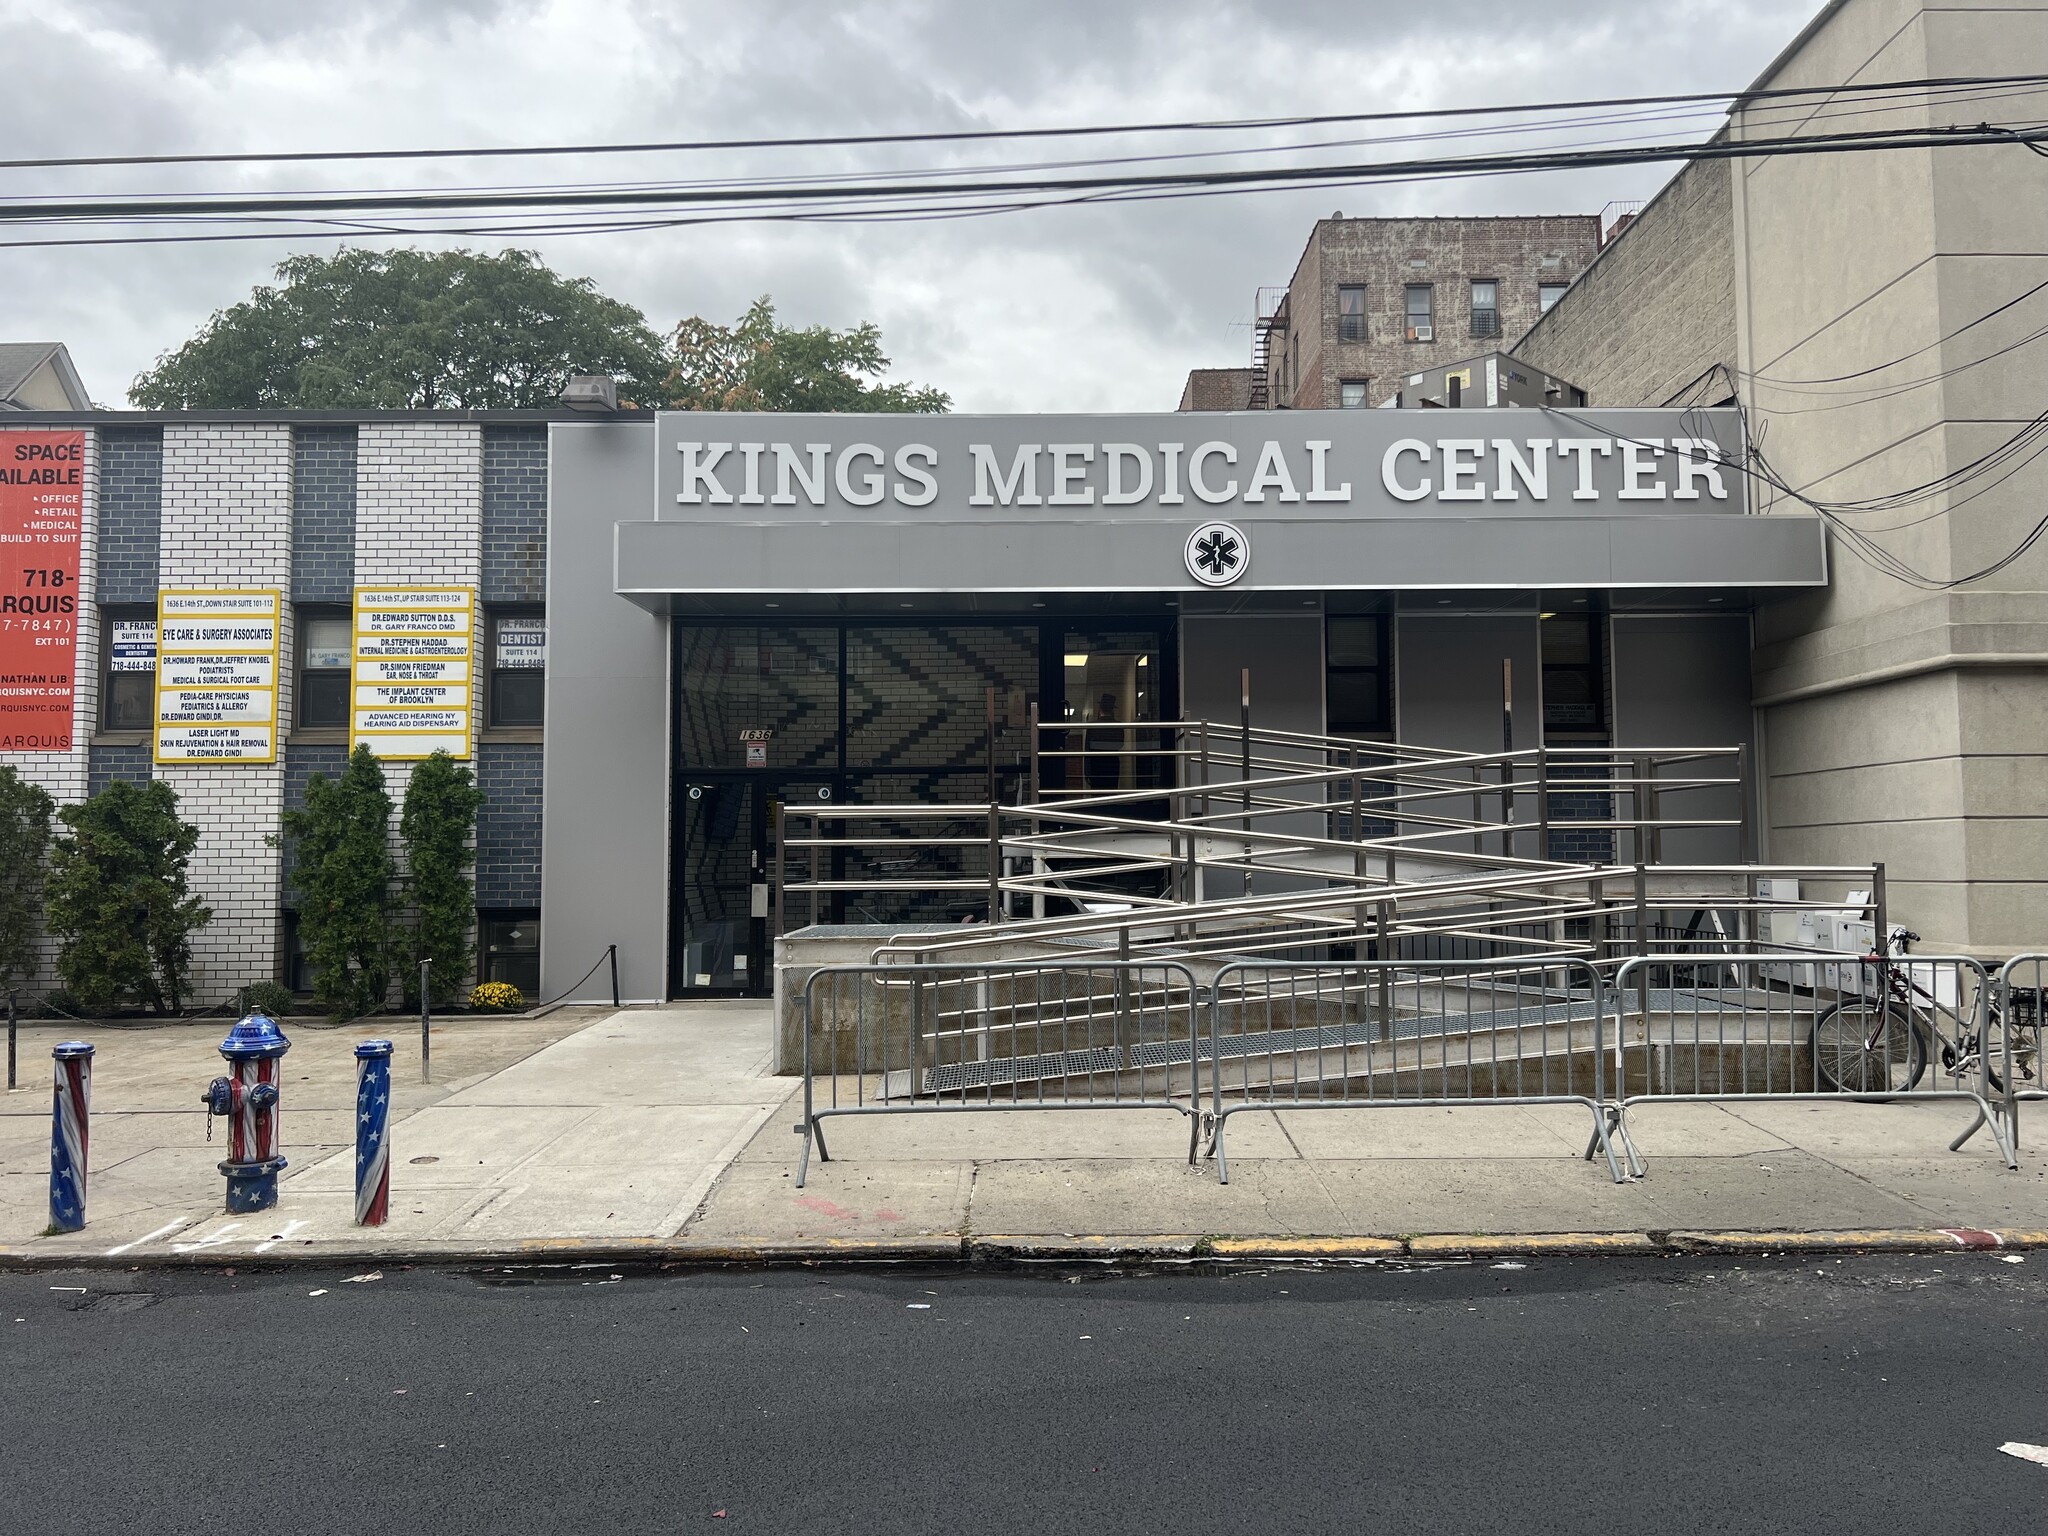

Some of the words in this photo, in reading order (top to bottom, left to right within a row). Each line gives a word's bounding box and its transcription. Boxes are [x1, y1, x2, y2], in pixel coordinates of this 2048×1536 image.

[15, 444, 81, 461] SPACE
[677, 442, 938, 506] KINGS
[969, 440, 1352, 506] MEDICAL
[1381, 438, 1728, 501] CENTER
[41, 495, 78, 503] OFFICE
[42, 508, 78, 516] RETAIL
[31, 521, 77, 529] MEDICAL
[1, 534, 32, 542] BUILD
[36, 534, 49, 542] TO
[53, 534, 77, 542] SUIT
[23, 570, 74, 587] 718-
[0, 596, 74, 615] RQUIS
[114, 622, 128, 630] DR.
[163, 629, 175, 640] EYE
[177, 629, 194, 640] CARE
[196, 629, 200, 640] &
[202, 629, 232, 640] SURGERY
[233, 629, 272, 640] ASSOCIATES
[501, 634, 542, 644] DENTIST
[112, 661, 156, 670] 718-444-848
[1, 675, 46, 683] NATHAN
[0, 688, 70, 696] QUISNYC.COM
[743, 731, 770, 739] 1636
[2, 735, 69, 747] ARQUIS
